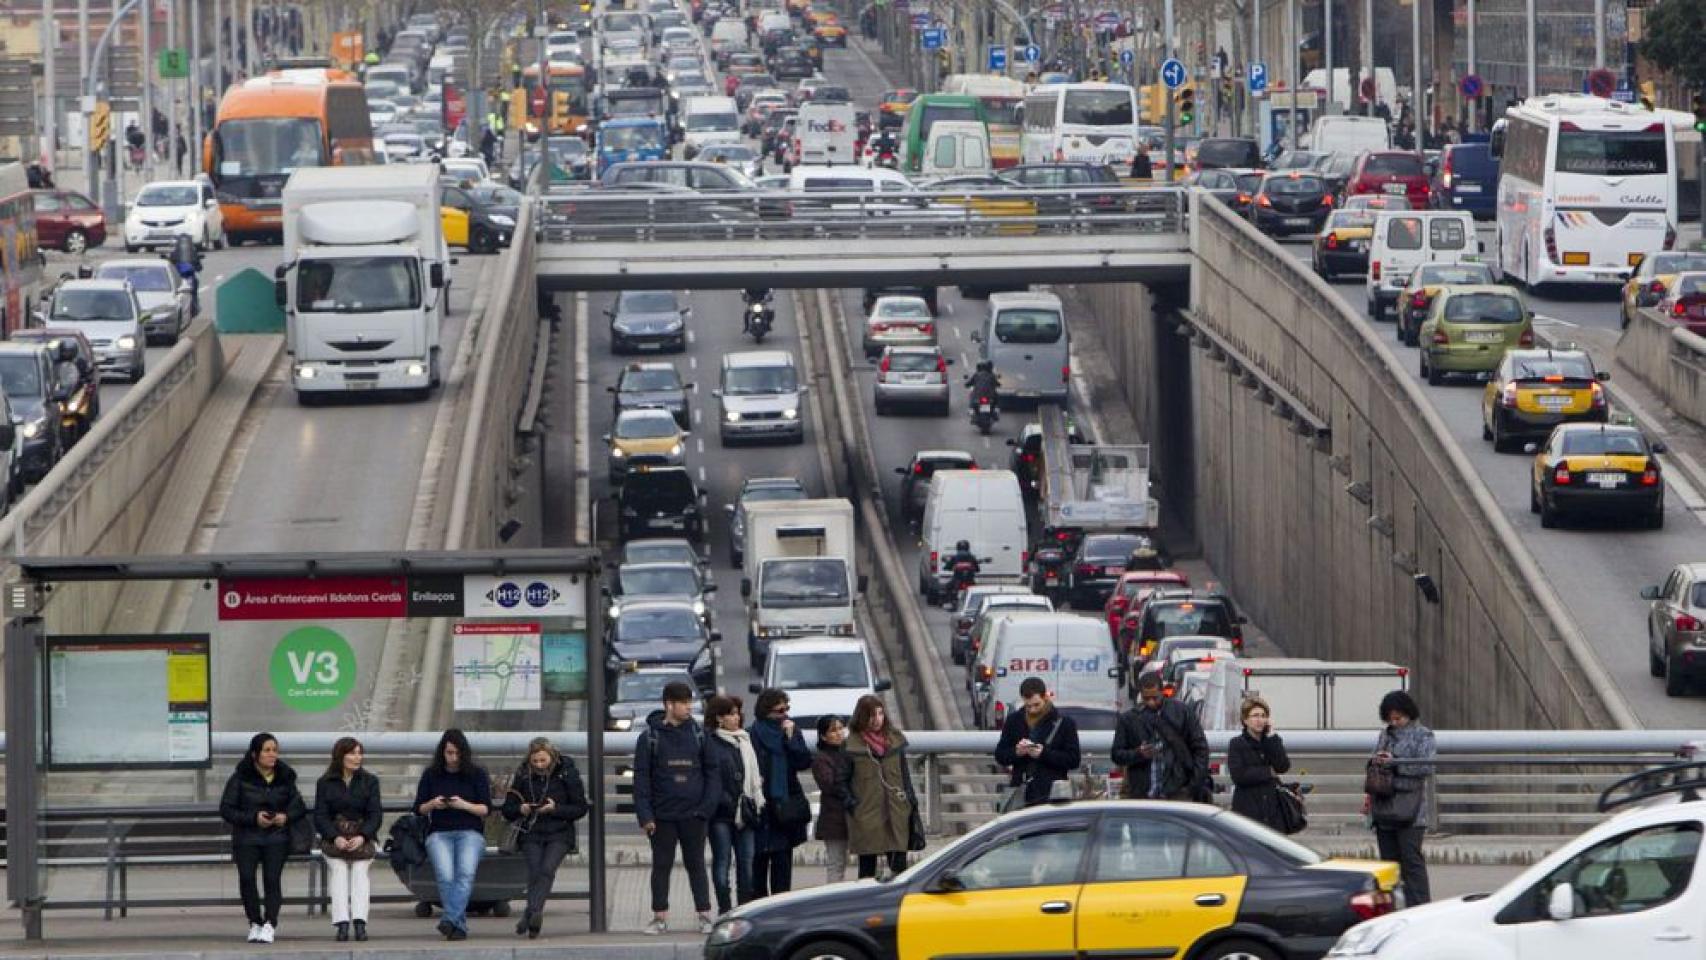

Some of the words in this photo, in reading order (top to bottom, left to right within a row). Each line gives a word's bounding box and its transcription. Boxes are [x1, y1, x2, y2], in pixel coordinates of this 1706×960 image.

[1251, 64, 1263, 80] P
[808, 119, 847, 132] FedEx
[412, 591, 455, 603] Enllaços
[497, 590, 521, 600] H12
[527, 590, 549, 600] H12
[287, 650, 340, 685] V3
[1009, 654, 1099, 673] arafred
